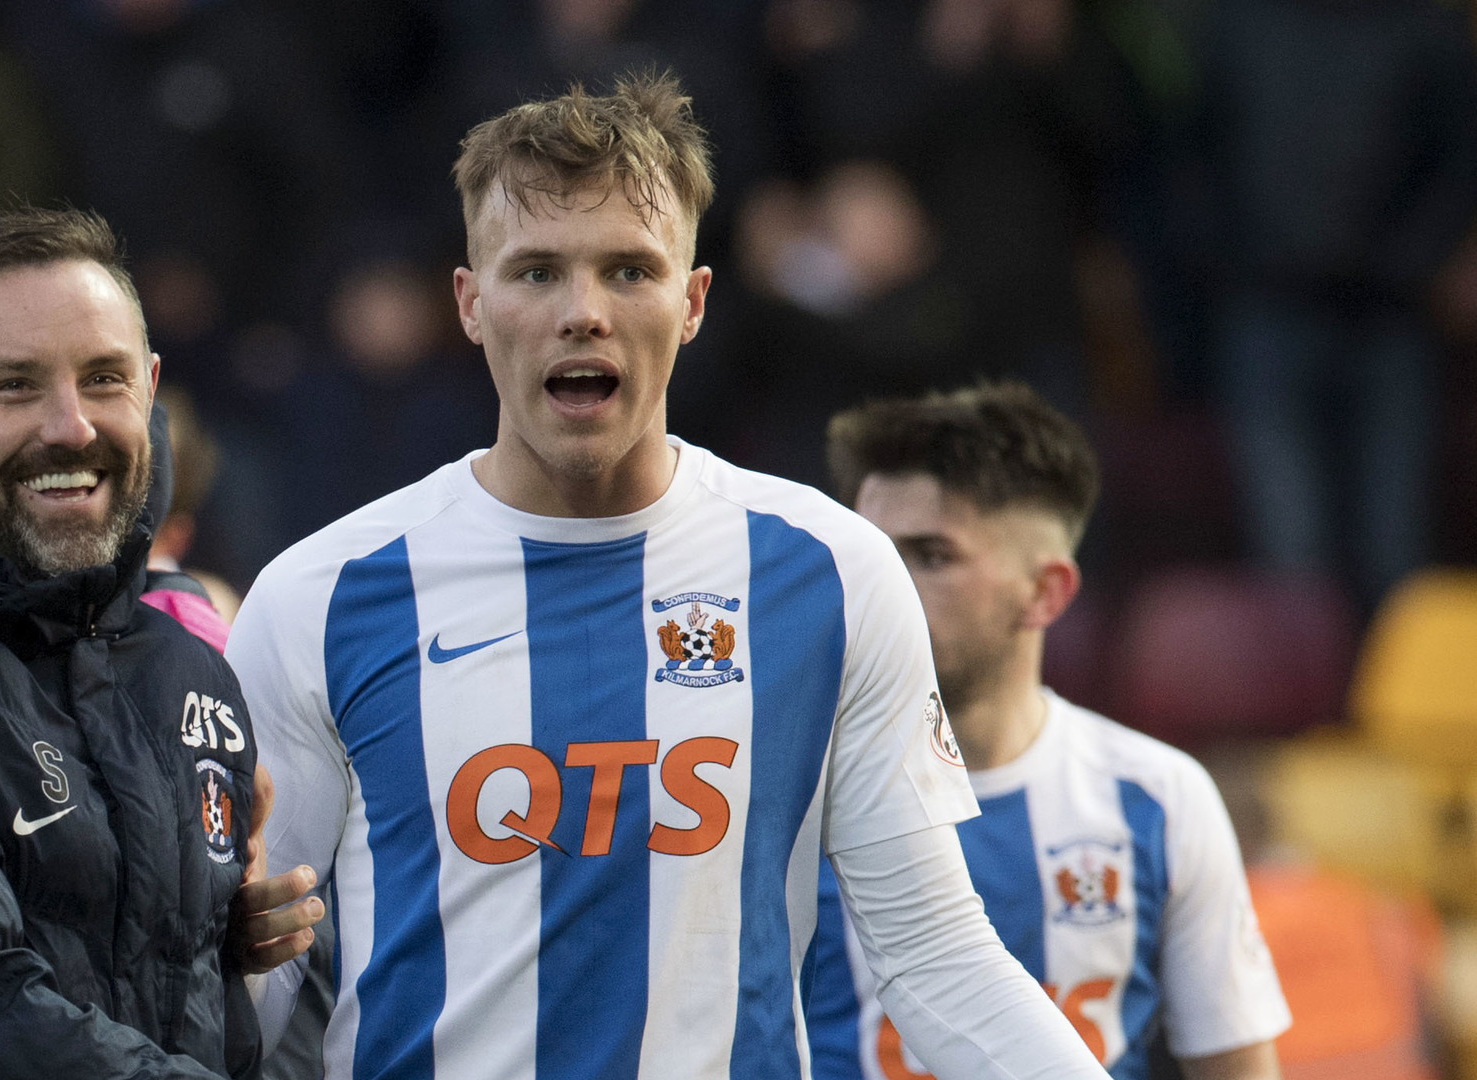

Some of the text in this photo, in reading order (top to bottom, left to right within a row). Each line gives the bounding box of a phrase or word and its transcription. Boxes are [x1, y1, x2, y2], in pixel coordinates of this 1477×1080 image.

[664, 593, 727, 607] CONFIDEMUS
[661, 670, 723, 687] KILMARNOCK
[181, 691, 245, 752] QTS
[33, 741, 70, 803] S
[446, 736, 739, 865] QTS
